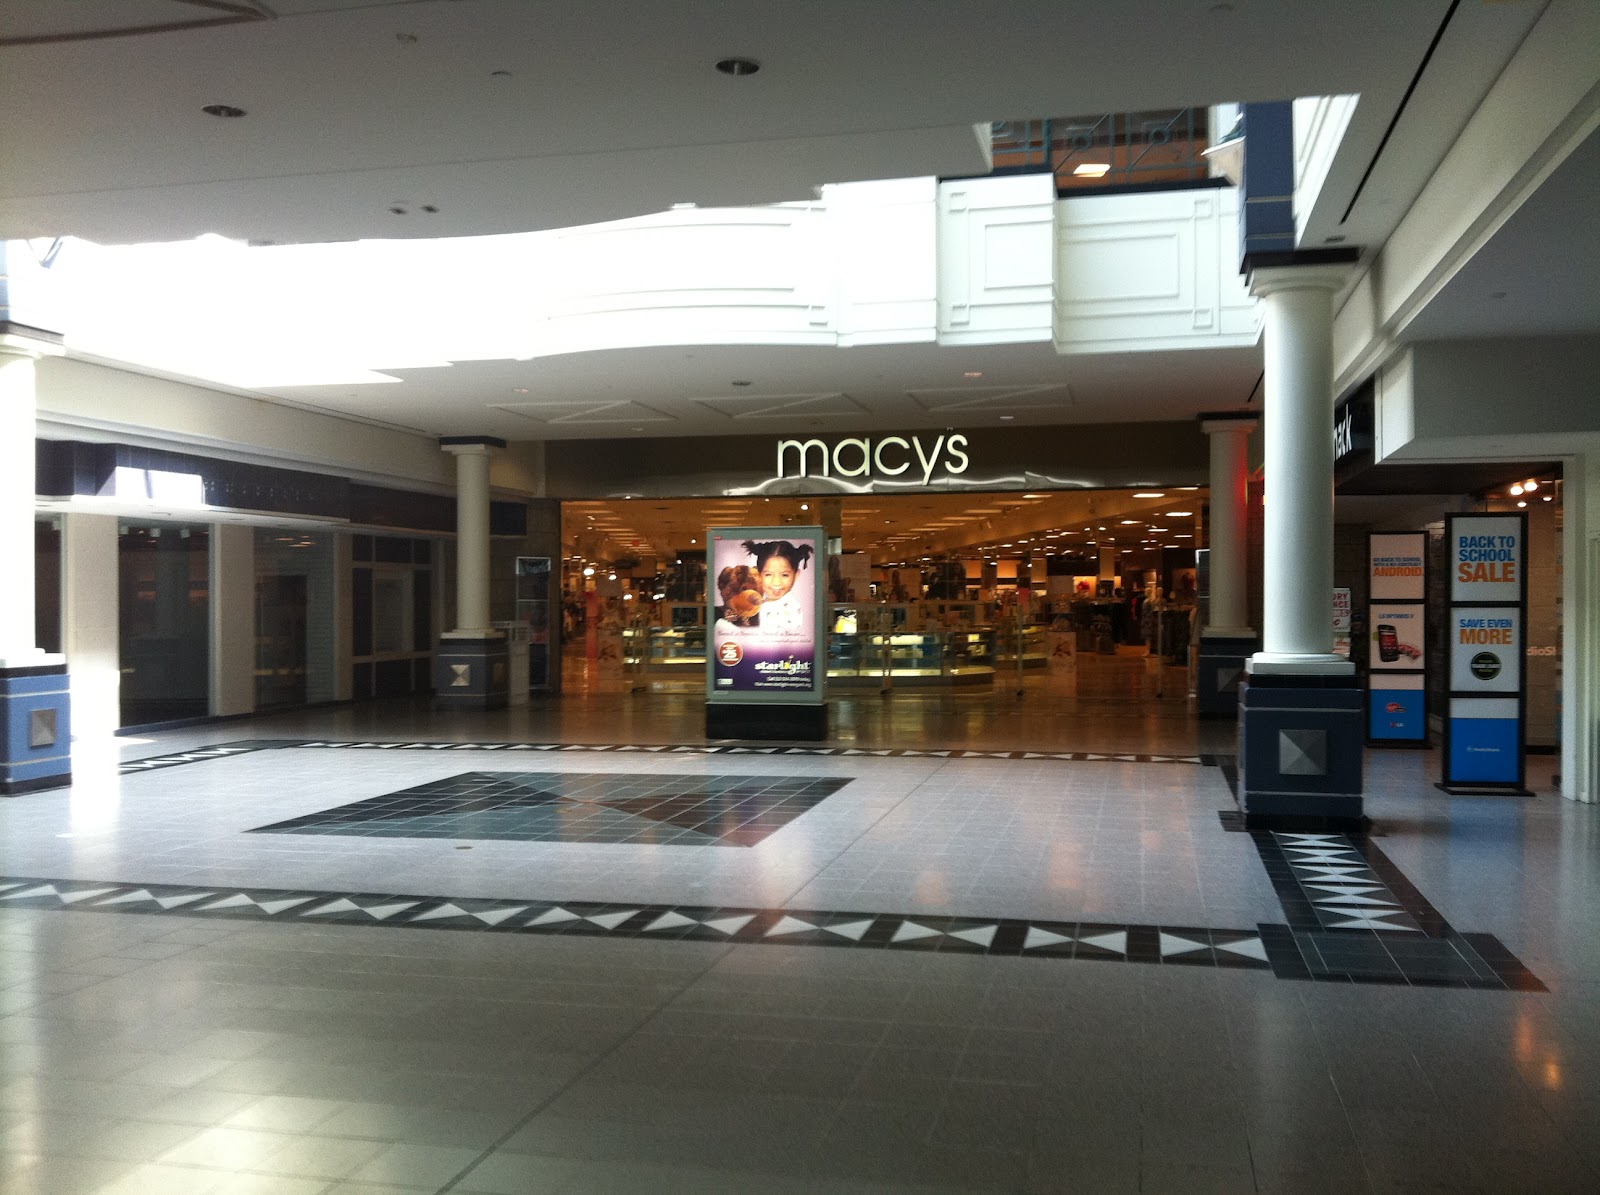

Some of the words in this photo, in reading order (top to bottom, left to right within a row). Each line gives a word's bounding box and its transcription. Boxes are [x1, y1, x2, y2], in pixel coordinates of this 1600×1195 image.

[777, 434, 969, 486] macys
[1459, 536, 1496, 549] BACK
[1498, 535, 1516, 549] TO
[1459, 549, 1516, 562] SCHOOL
[1372, 566, 1422, 577] ANDROID
[1458, 562, 1516, 583] SALE
[1459, 619, 1486, 628] SAVE
[1487, 619, 1513, 628] EVEN
[1459, 628, 1513, 645] MORE
[754, 655, 812, 675] starlight
